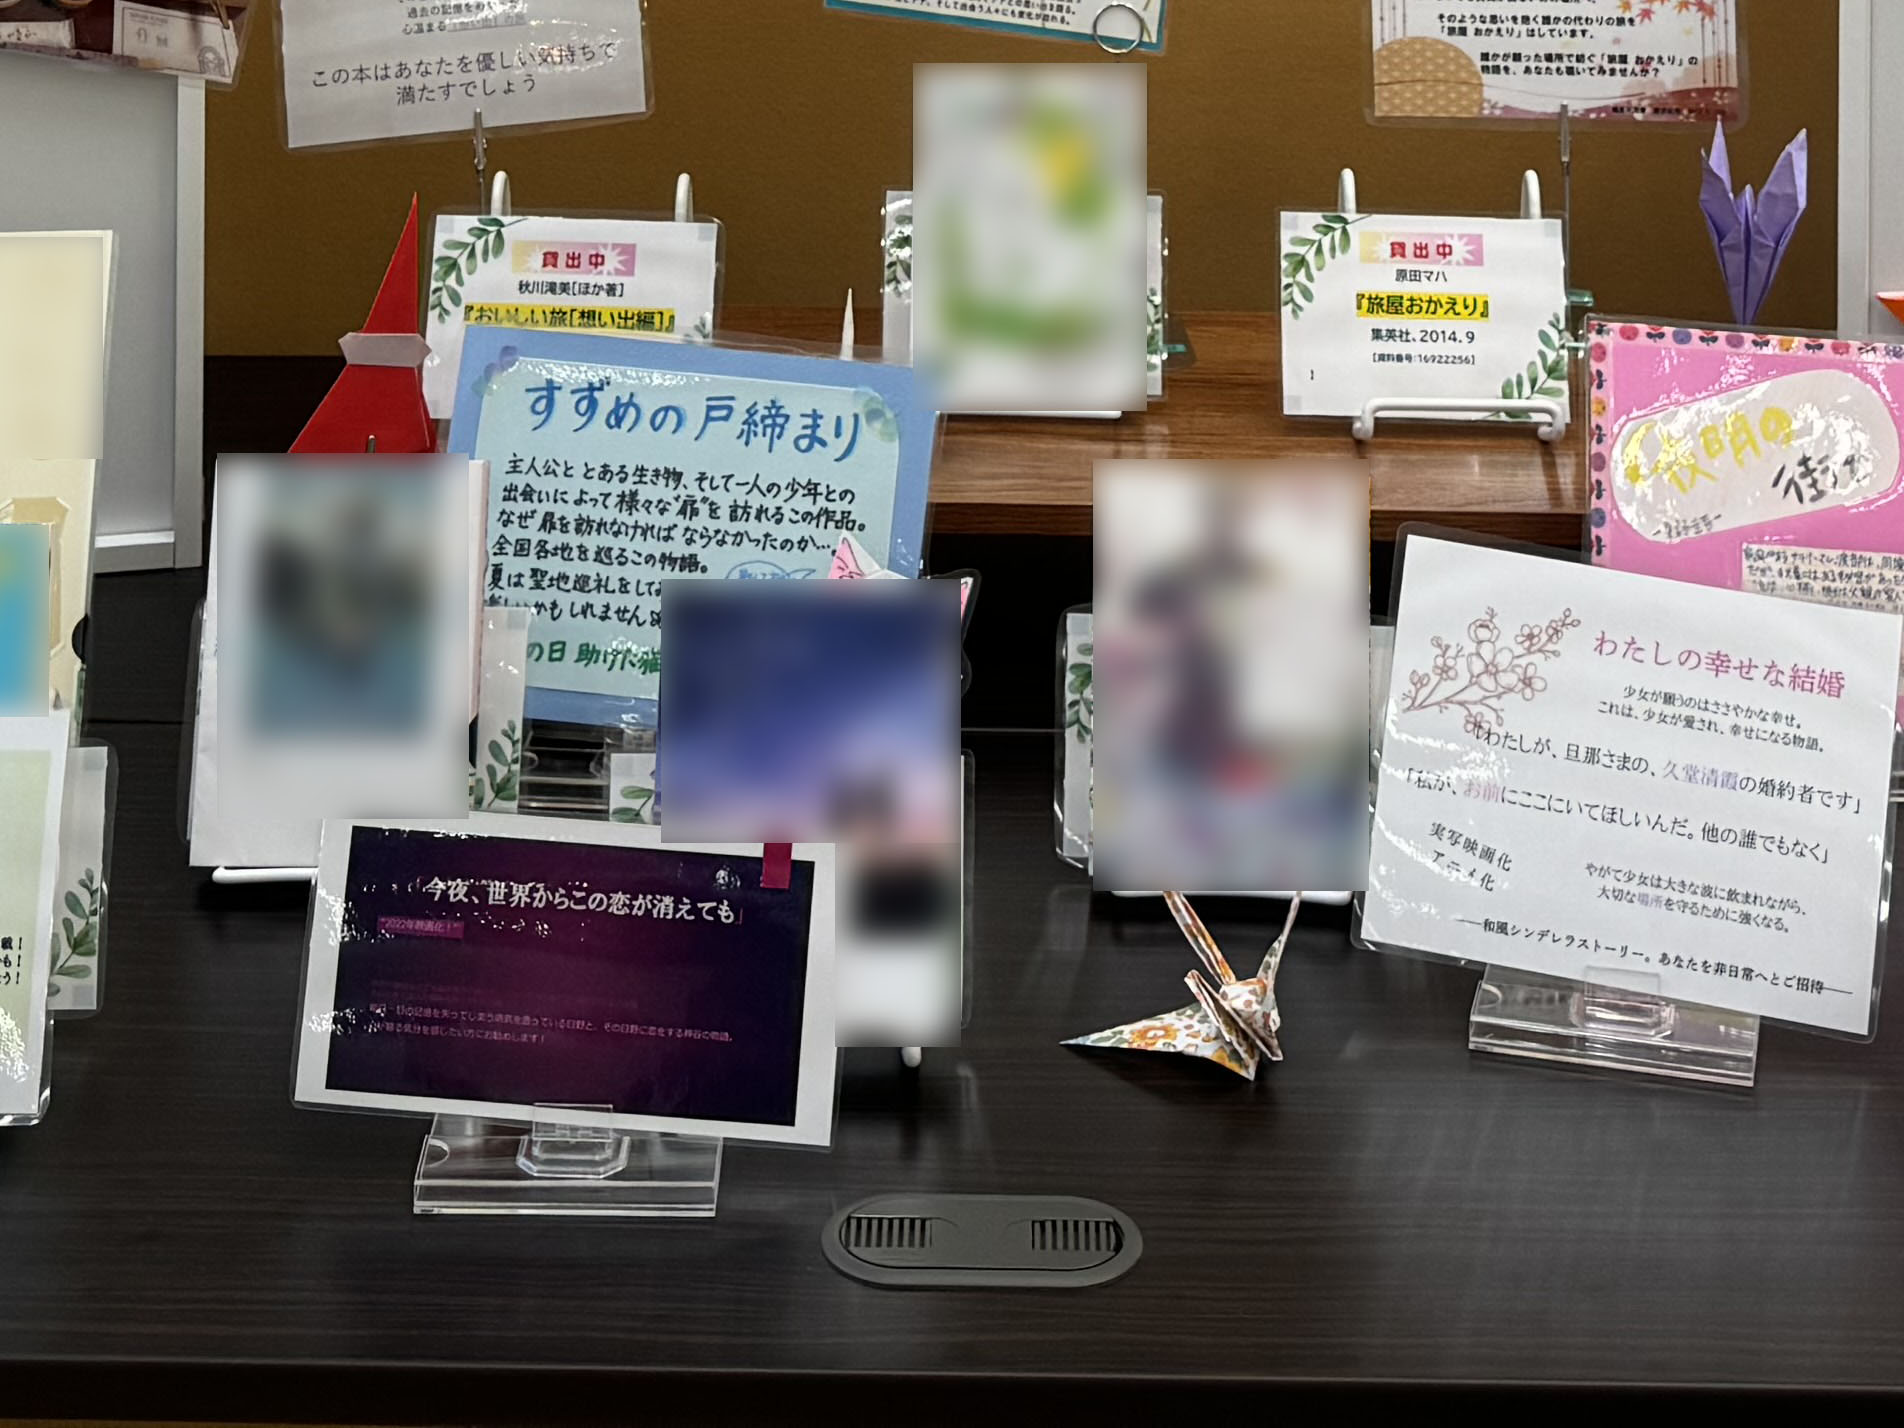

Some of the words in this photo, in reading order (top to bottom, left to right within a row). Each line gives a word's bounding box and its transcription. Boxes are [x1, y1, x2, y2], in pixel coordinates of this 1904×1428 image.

[396, 73, 537, 106] 満たすでしょう
[542, 251, 606, 270] 貸出中
[1389, 241, 1453, 260] 貸出中
[1395, 269, 1448, 283] 原田マハ
[1356, 293, 1489, 319] 『旅屋おかえり』
[525, 376, 861, 463] すずめの戸締まり
[1592, 630, 1846, 699] わたしの幸せな結婚
[1597, 700, 1826, 753] これは、少女が愛され、幸せになる物語。
[1623, 685, 1803, 730] 少女が願うのはささやかな幸せ。
[1428, 822, 1512, 872] 実写映画化
